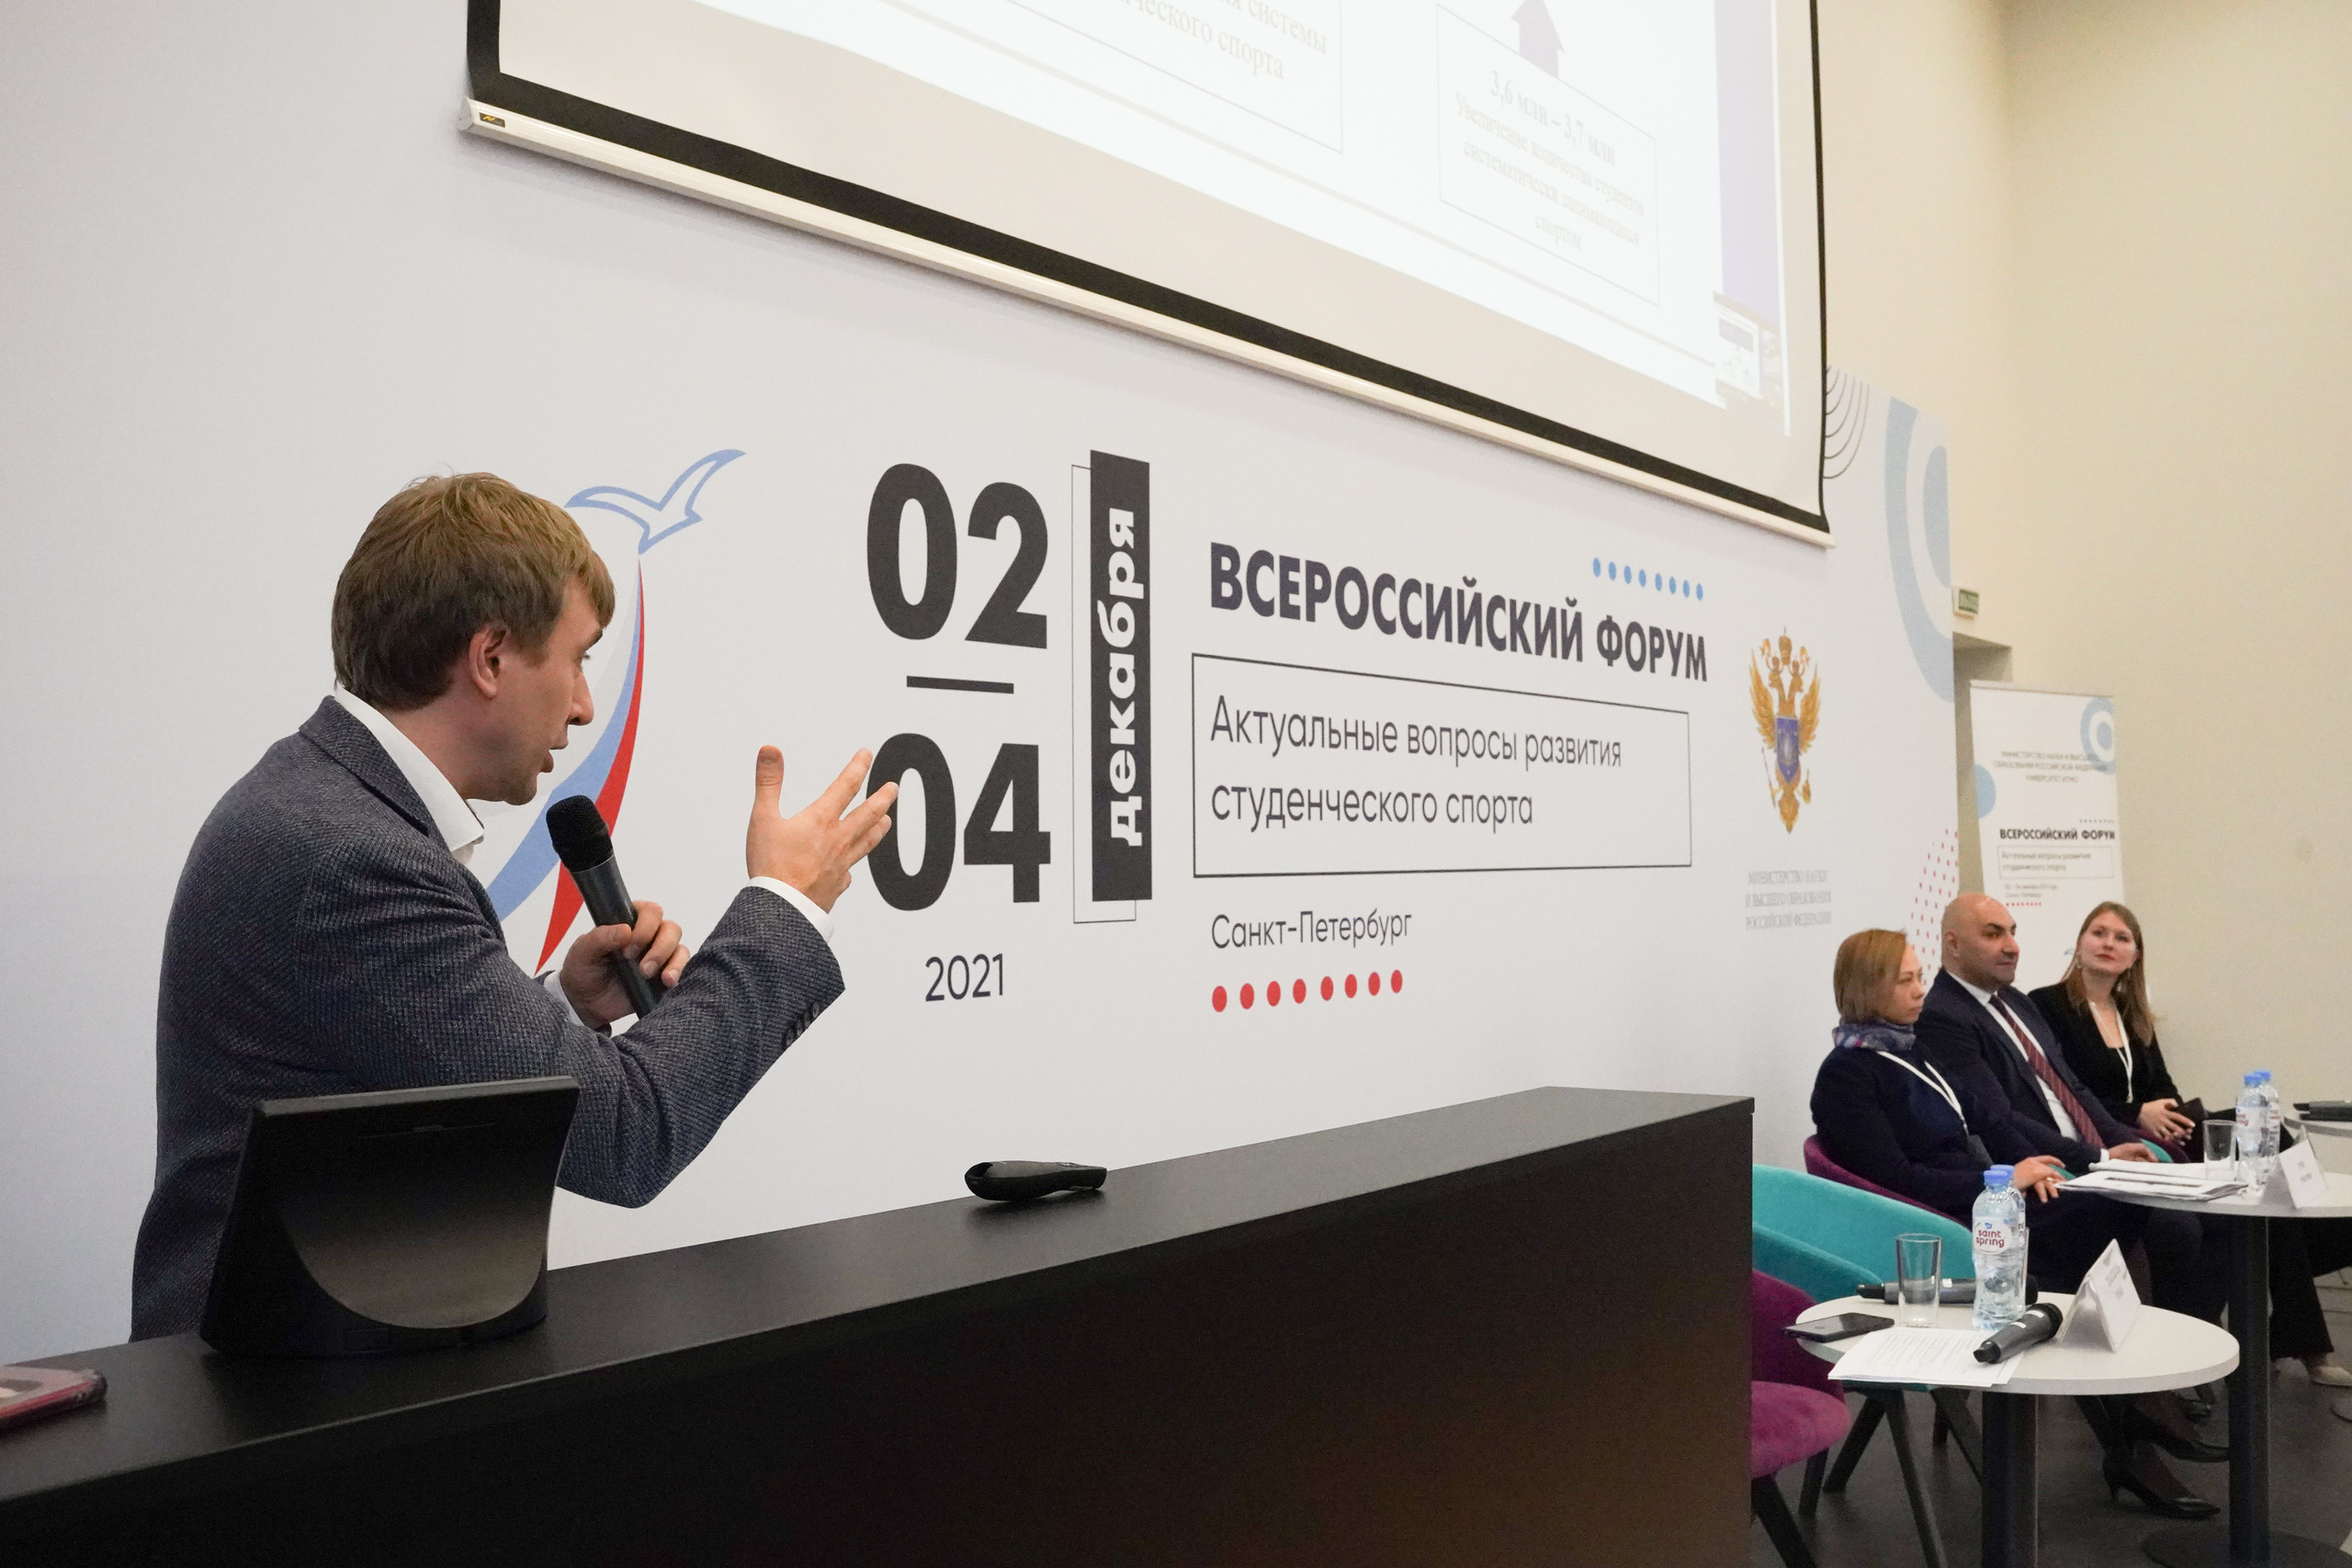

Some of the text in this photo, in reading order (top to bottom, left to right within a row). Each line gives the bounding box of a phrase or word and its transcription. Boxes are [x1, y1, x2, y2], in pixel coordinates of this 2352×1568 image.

[1218, 30, 1284, 79] спорта
[1489, 70, 1514, 106] 3,6
[1517, 92, 1548, 127] млн
[1564, 113, 1585, 147] 3,7
[1588, 134, 1615, 166] млн
[1534, 214, 1582, 251] спортом
[867, 463, 1048, 649] 02
[1210, 541, 1708, 682] ВСЕРОССИЙСКИЙ ФОРУМ
[1098, 507, 1144, 847] декабря
[1210, 694, 1623, 771] Актуальные вопросы развития
[866, 733, 1051, 911] 04
[1210, 784, 1533, 834] студенческого спорта
[1211, 908, 1412, 949] Санкт-Петербург
[925, 953, 1005, 1002] 2021
[1976, 1236, 2005, 1247] spring
[1978, 1230, 2002, 1238] saint
